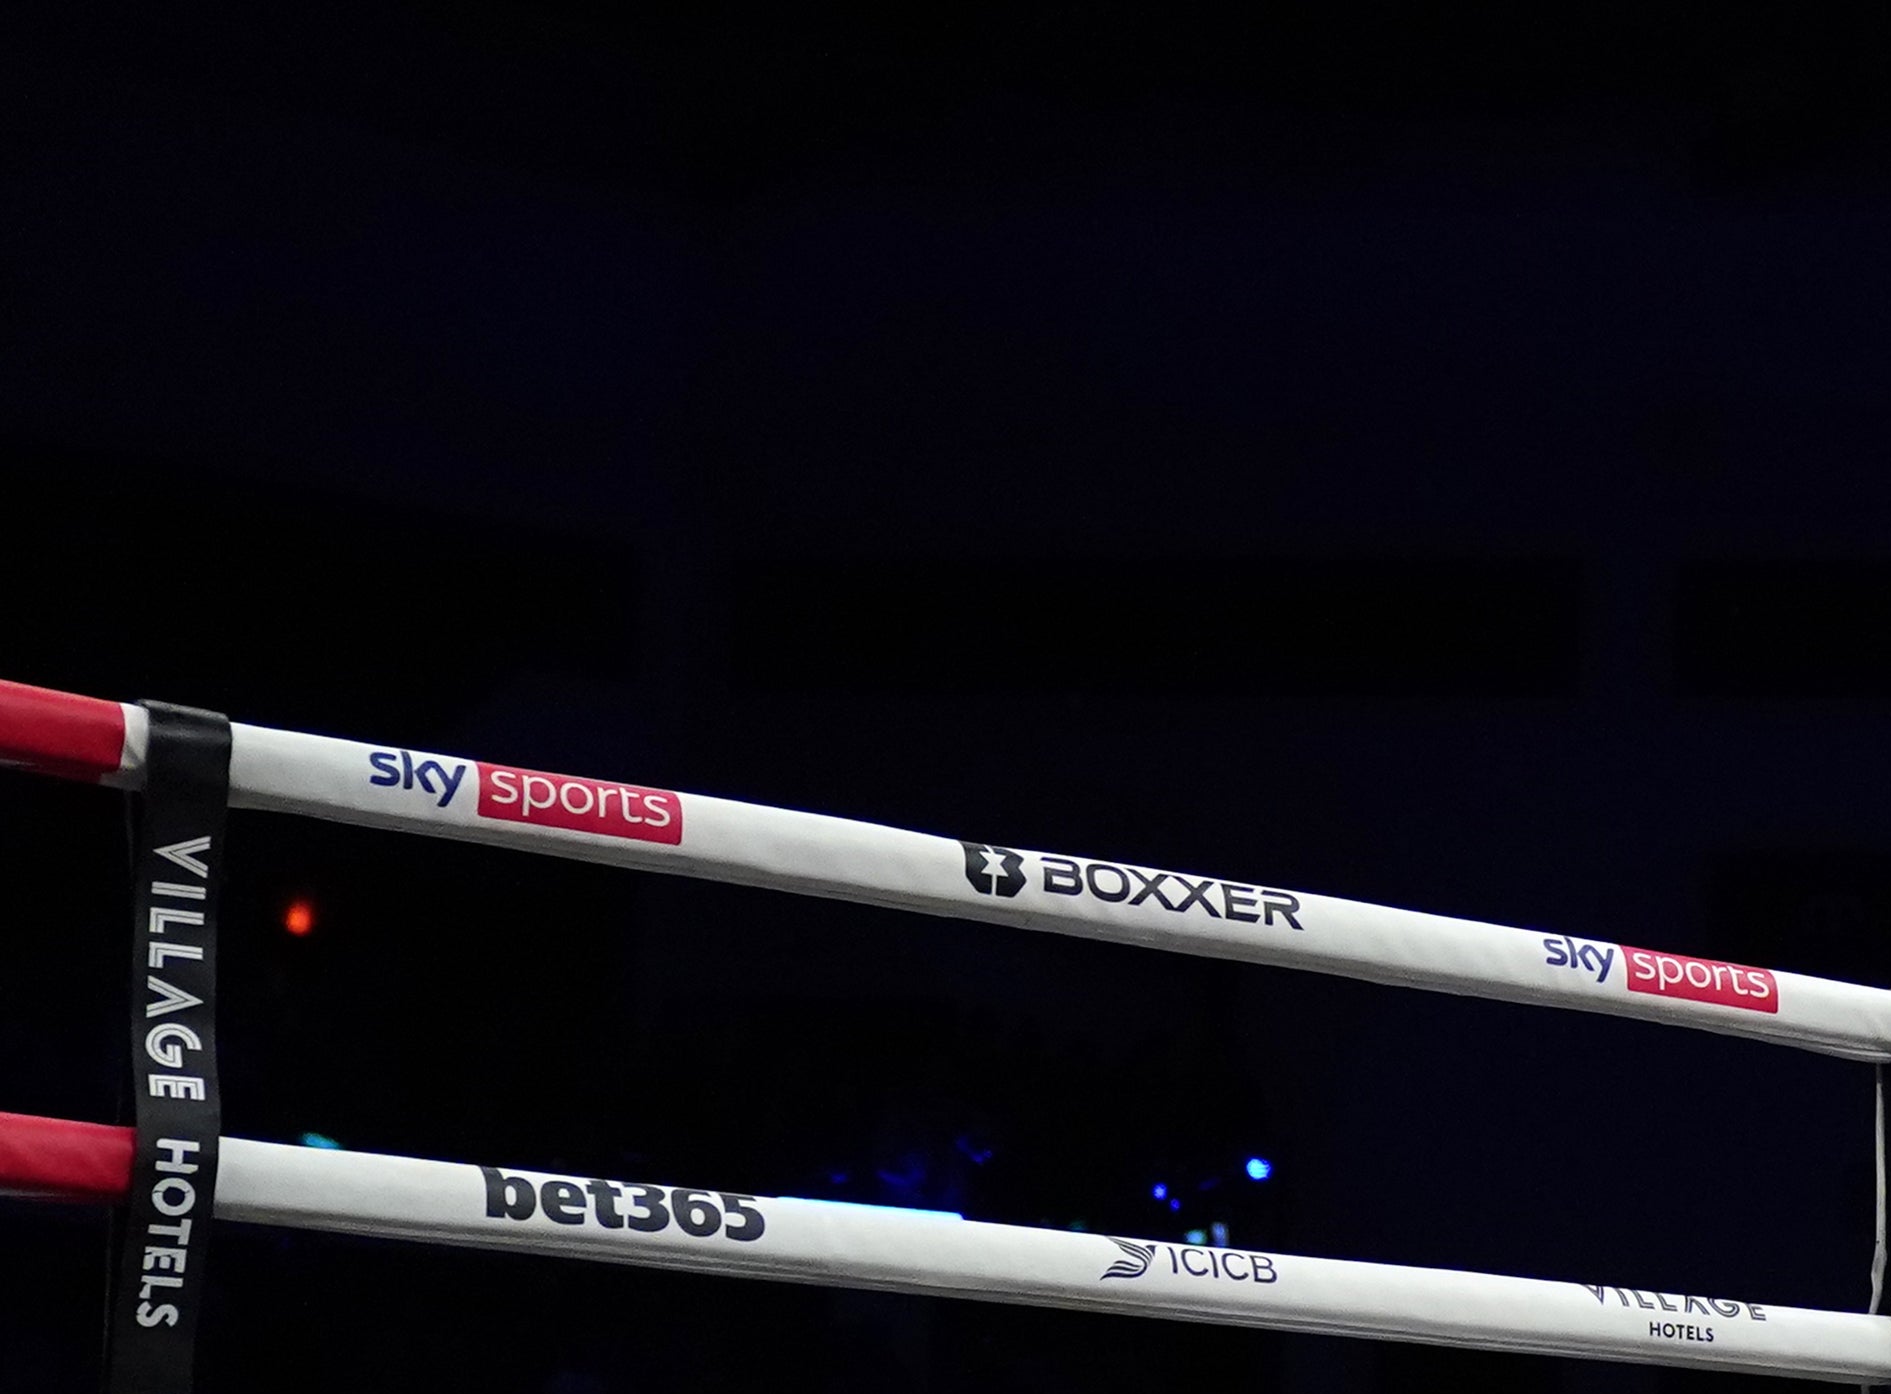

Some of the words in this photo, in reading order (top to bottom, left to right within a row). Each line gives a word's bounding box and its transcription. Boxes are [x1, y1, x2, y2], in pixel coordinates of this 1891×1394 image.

[368, 748, 467, 807] sky
[489, 769, 673, 829] sports
[1041, 856, 1305, 932] BOXXER
[145, 835, 212, 1102] VILLAGE
[1543, 936, 1615, 983] sky
[1632, 950, 1771, 998] sports
[136, 1137, 200, 1328] HOTELS
[479, 1165, 766, 1243] bet365
[1171, 1248, 1279, 1285] ICICB
[1584, 1283, 1767, 1321] VILLAGE
[1648, 1321, 1715, 1342] HOTELS
